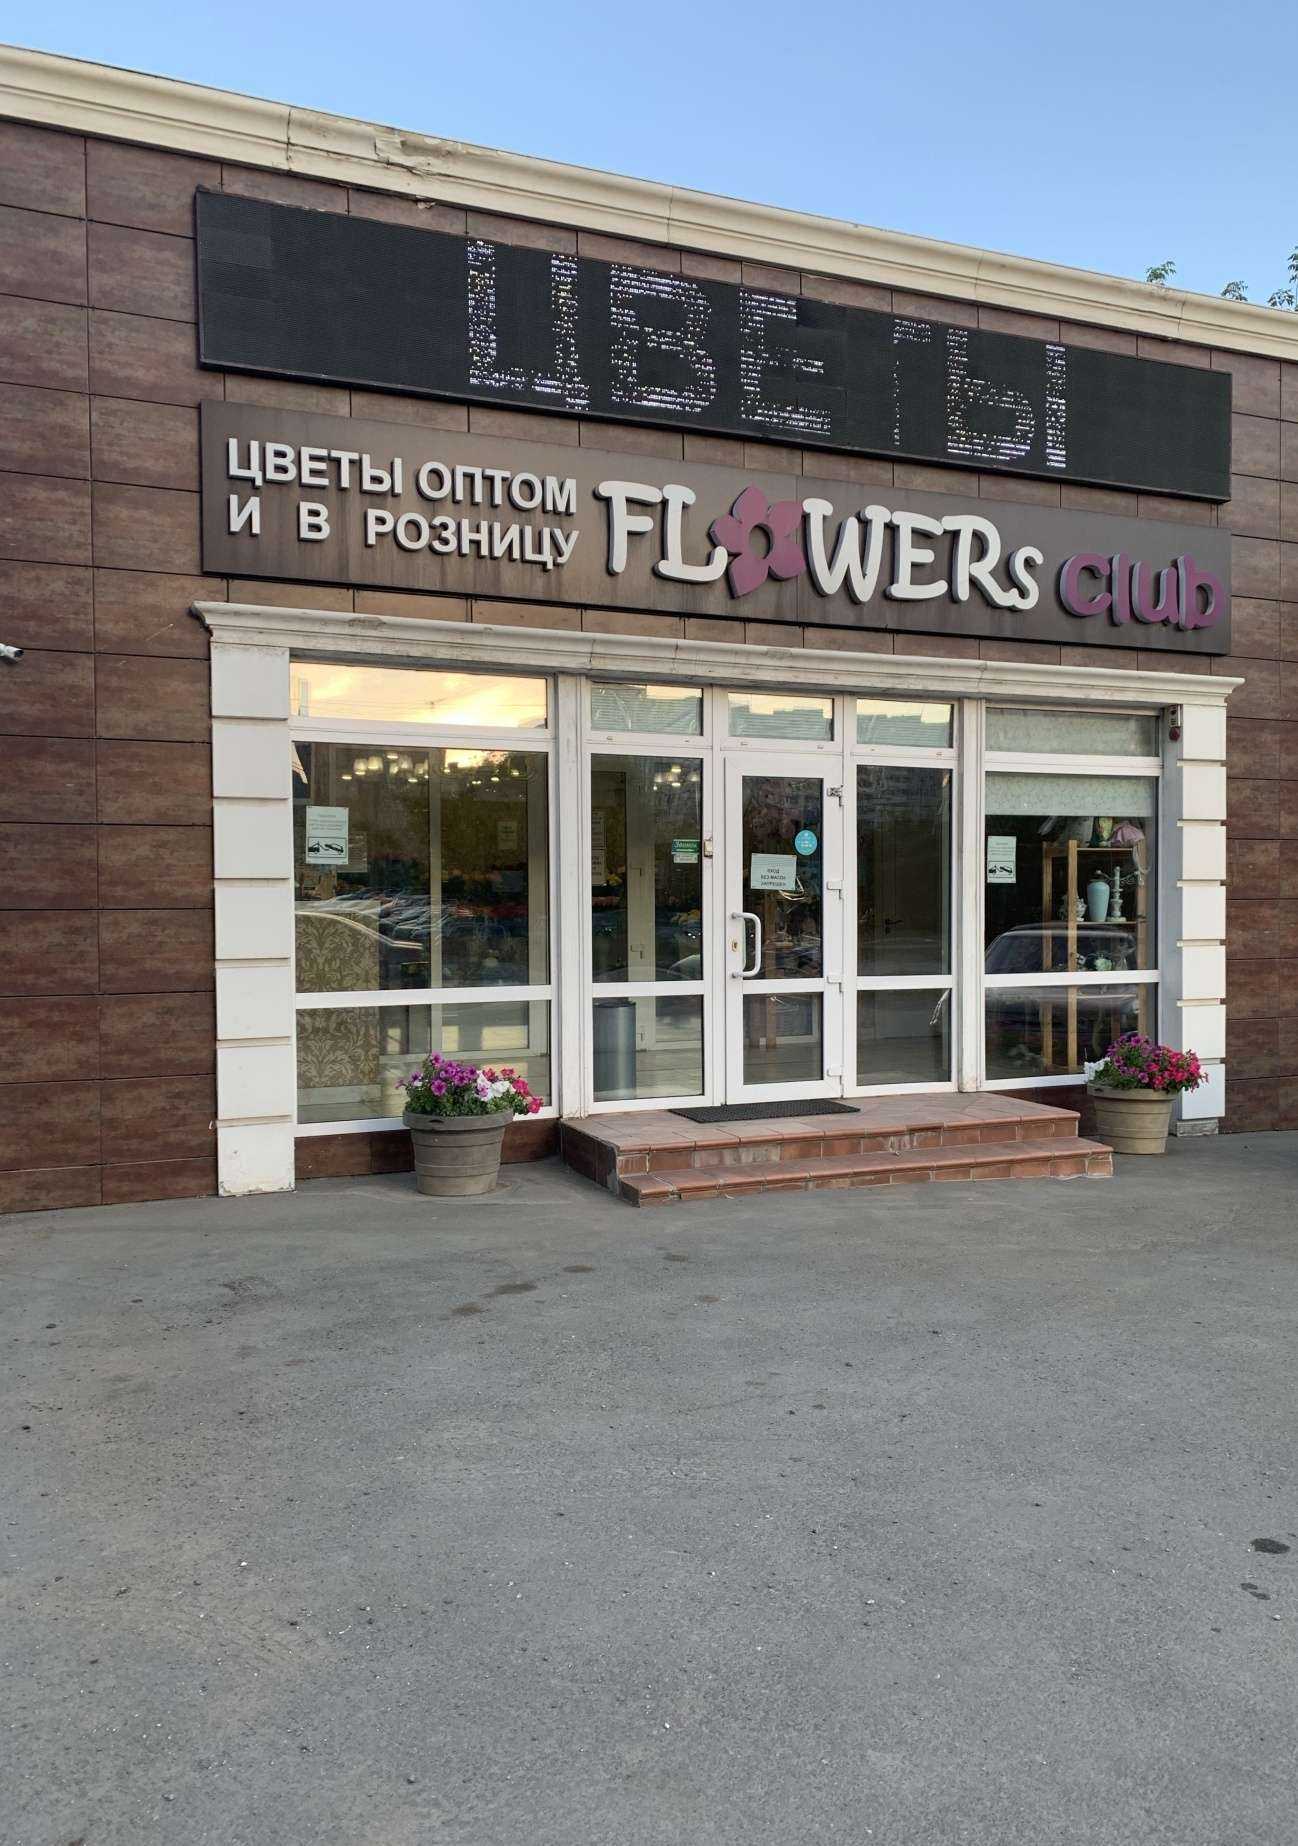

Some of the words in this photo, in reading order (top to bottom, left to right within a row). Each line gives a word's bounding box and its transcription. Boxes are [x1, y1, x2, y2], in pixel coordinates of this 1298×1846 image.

[227, 437, 403, 495] ЦВЕТЫ
[415, 461, 578, 515] ОПТОМ
[227, 494, 262, 536] И
[297, 500, 331, 542] В
[364, 508, 580, 571] РОЗНИЦУ
